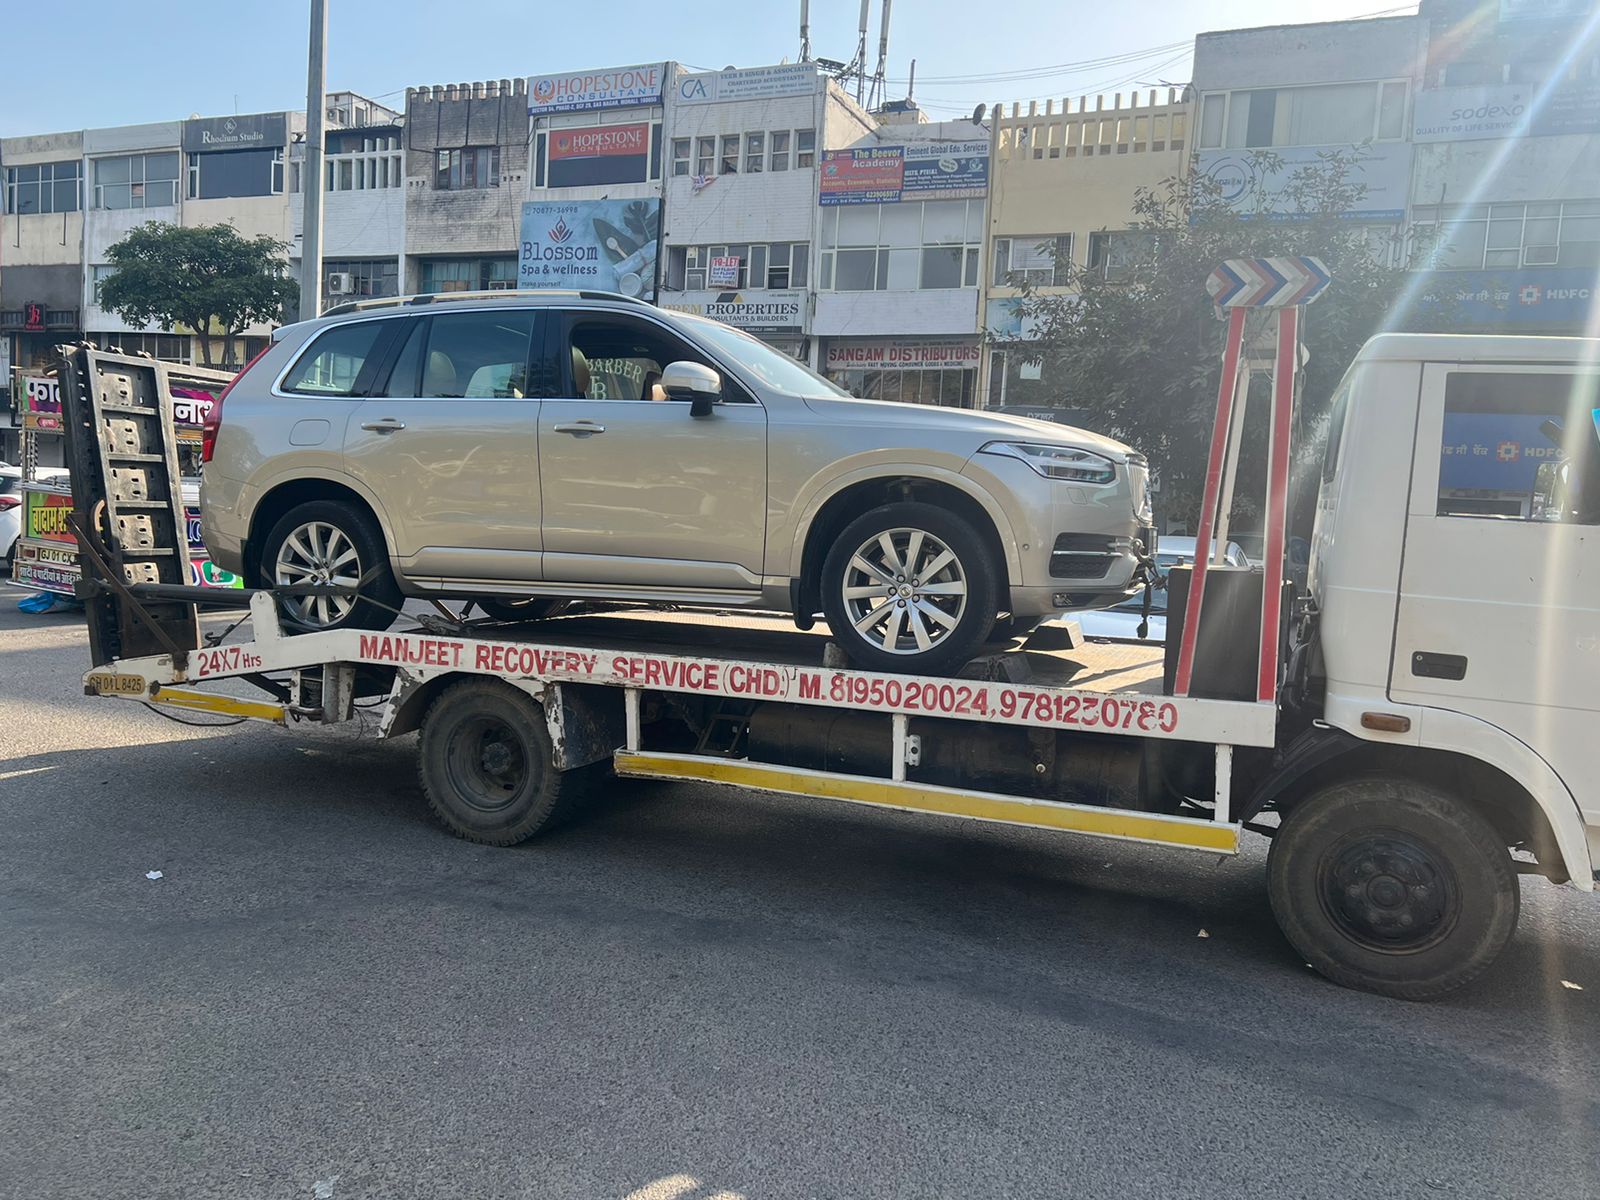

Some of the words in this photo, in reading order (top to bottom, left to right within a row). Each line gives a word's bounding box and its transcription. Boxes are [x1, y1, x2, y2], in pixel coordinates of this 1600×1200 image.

[557, 69, 658, 95] HOPESTONE
[557, 87, 655, 103] CONSULTANT
[1451, 104, 1525, 121] sodexo
[240, 132, 263, 141] Studio
[1416, 126, 1450, 136] QUALITY
[1452, 125, 1463, 133] OF
[573, 130, 643, 147] HOPESTONE
[573, 142, 641, 153] CONSULTANT
[854, 149, 869, 158] The
[963, 143, 987, 152] Services
[852, 159, 900, 168] Academy
[522, 241, 598, 261] Blossom
[713, 257, 738, 267] TO-LET
[521, 264, 540, 276] Spa
[542, 264, 550, 274] &
[552, 264, 598, 275] wellness
[1546, 289, 1590, 300] HDFC
[706, 303, 799, 315] PROPERTIES
[829, 347, 884, 361] SANGAM
[889, 346, 980, 361] DISTRIBUTORS
[586, 358, 642, 383] BARBER
[1524, 446, 1567, 458] HDFC
[41, 549, 51, 560] GJ
[52, 551, 60, 561] 01
[359, 634, 465, 667] MANJEET
[475, 644, 598, 675] RECOVERY
